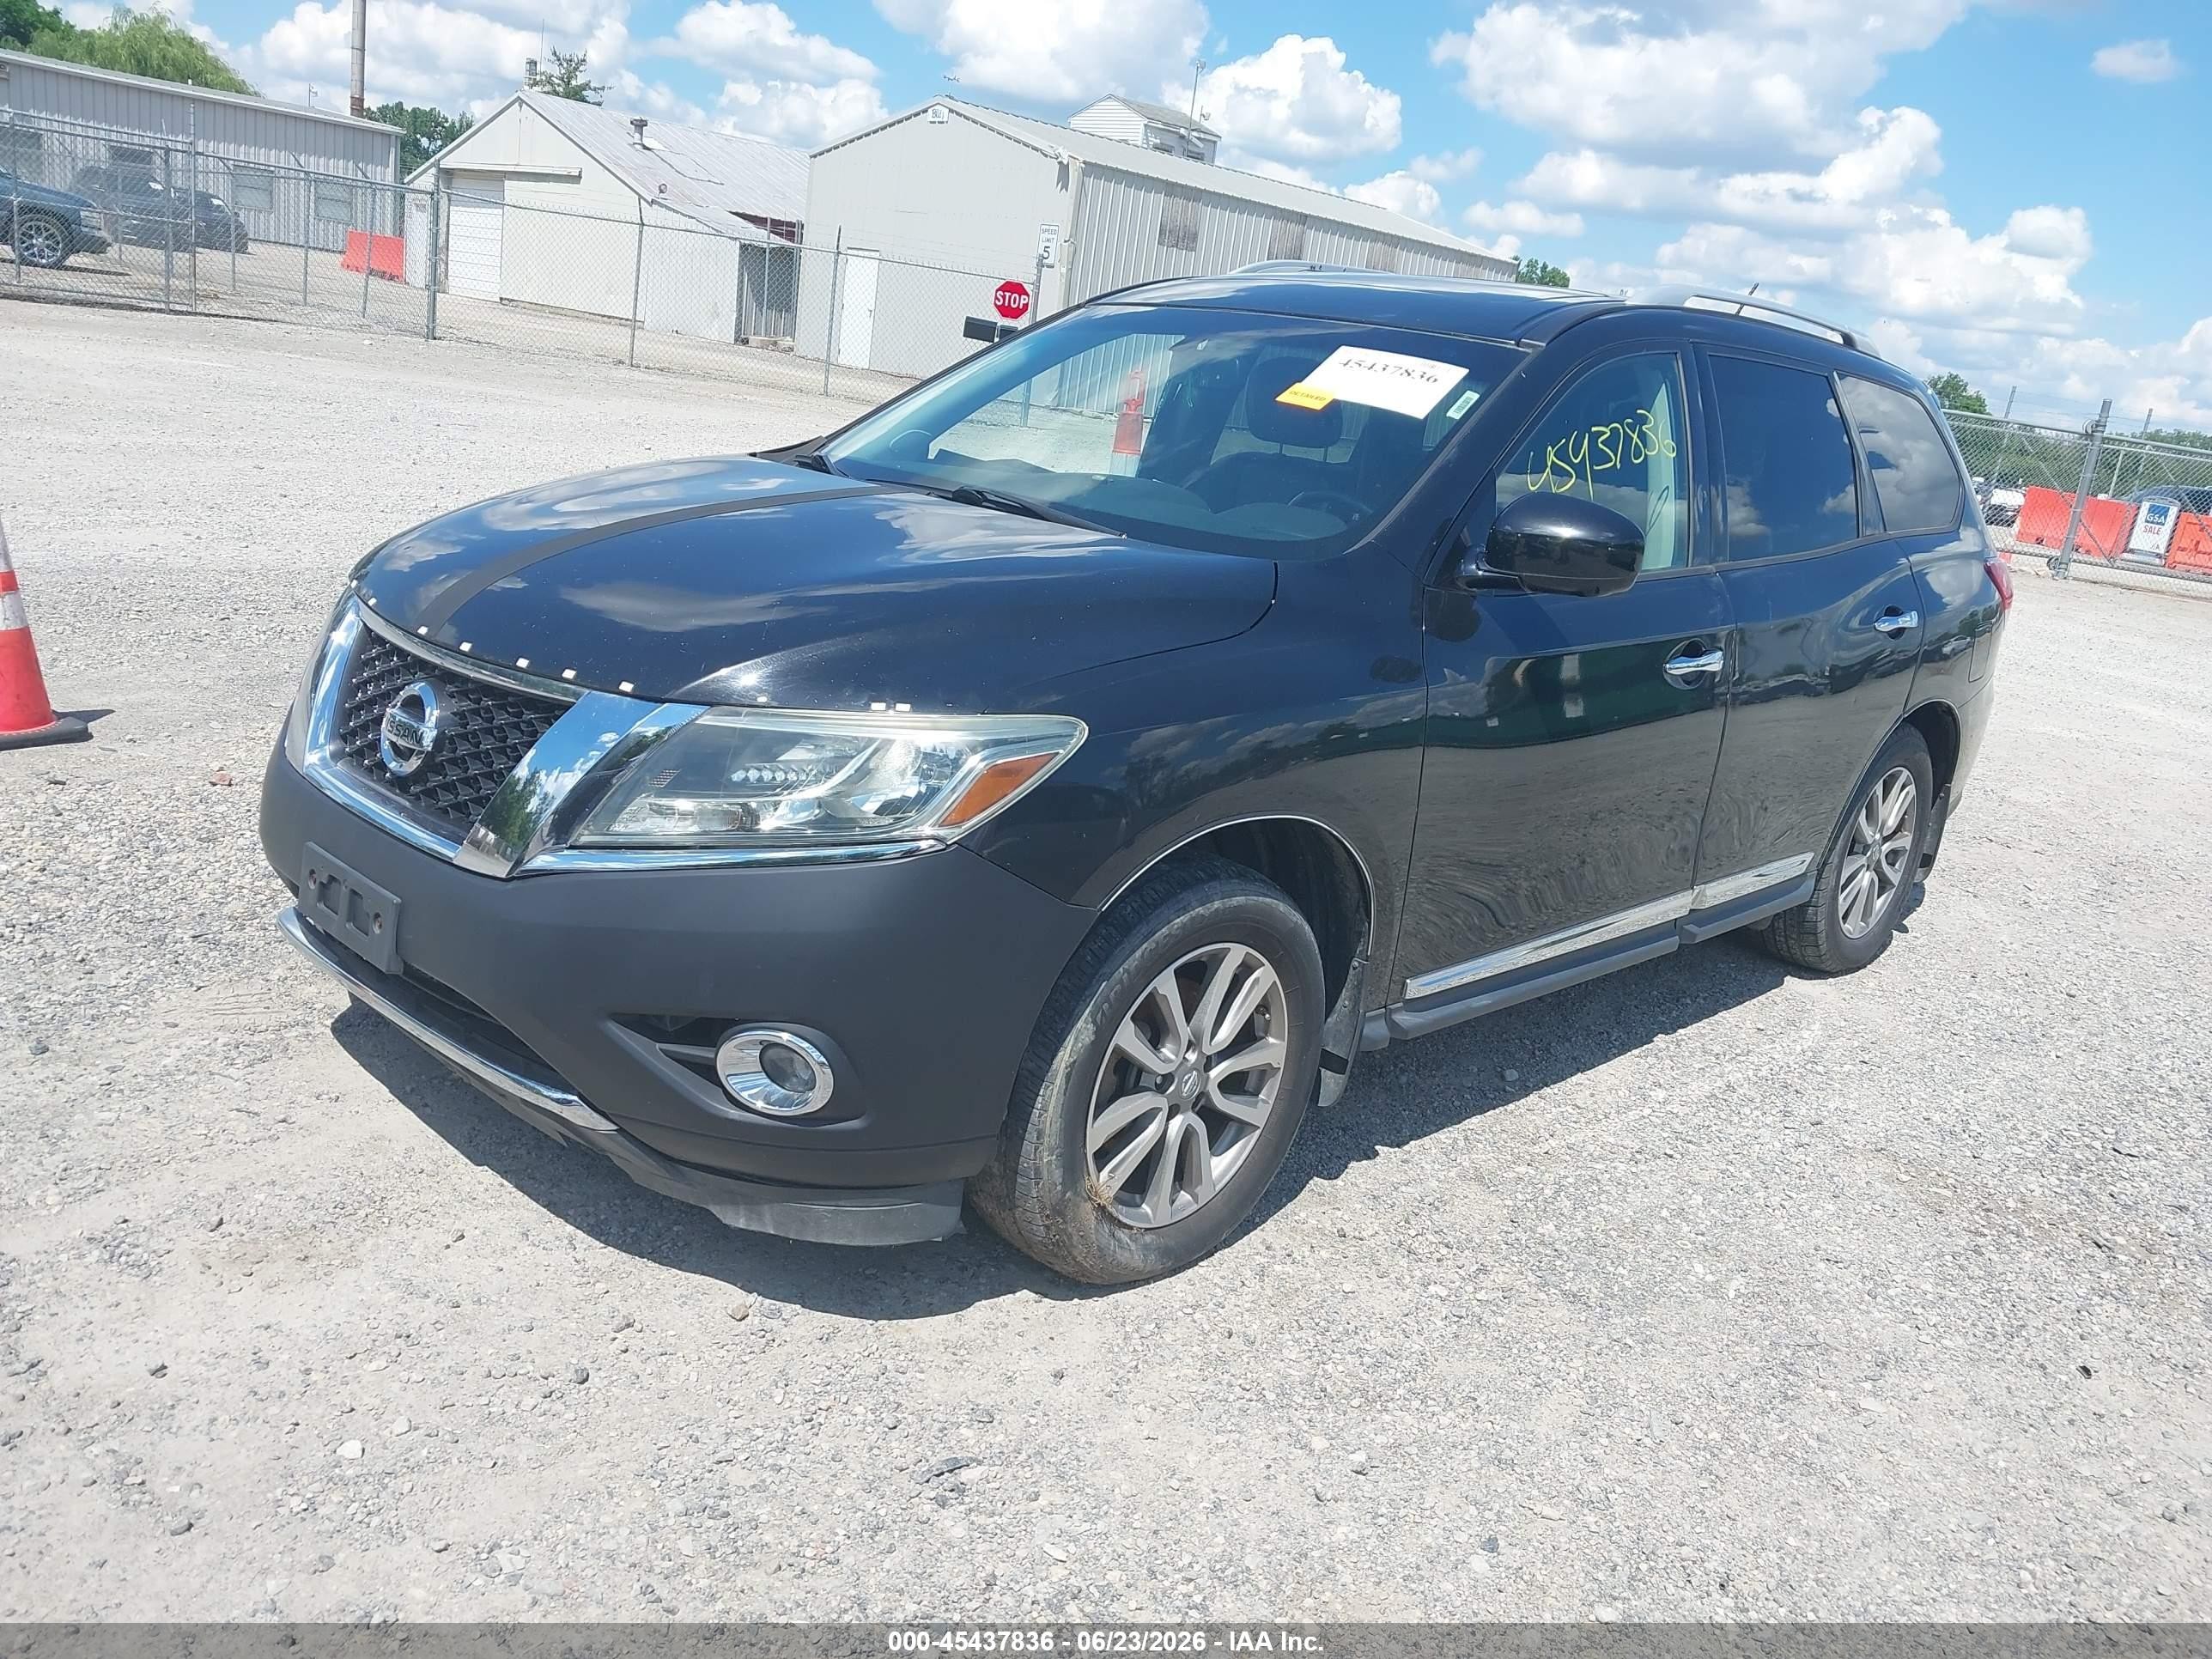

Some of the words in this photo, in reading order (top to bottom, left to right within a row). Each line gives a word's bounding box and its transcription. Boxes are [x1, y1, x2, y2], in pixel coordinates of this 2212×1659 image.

[1042, 246, 1051, 259] 5
[995, 290, 1029, 309] STOP
[1339, 357, 1439, 384] 45437836
[1526, 409, 1676, 502] 45437836
[2146, 513, 2166, 524] GSA
[2142, 524, 2162, 535] SALE
